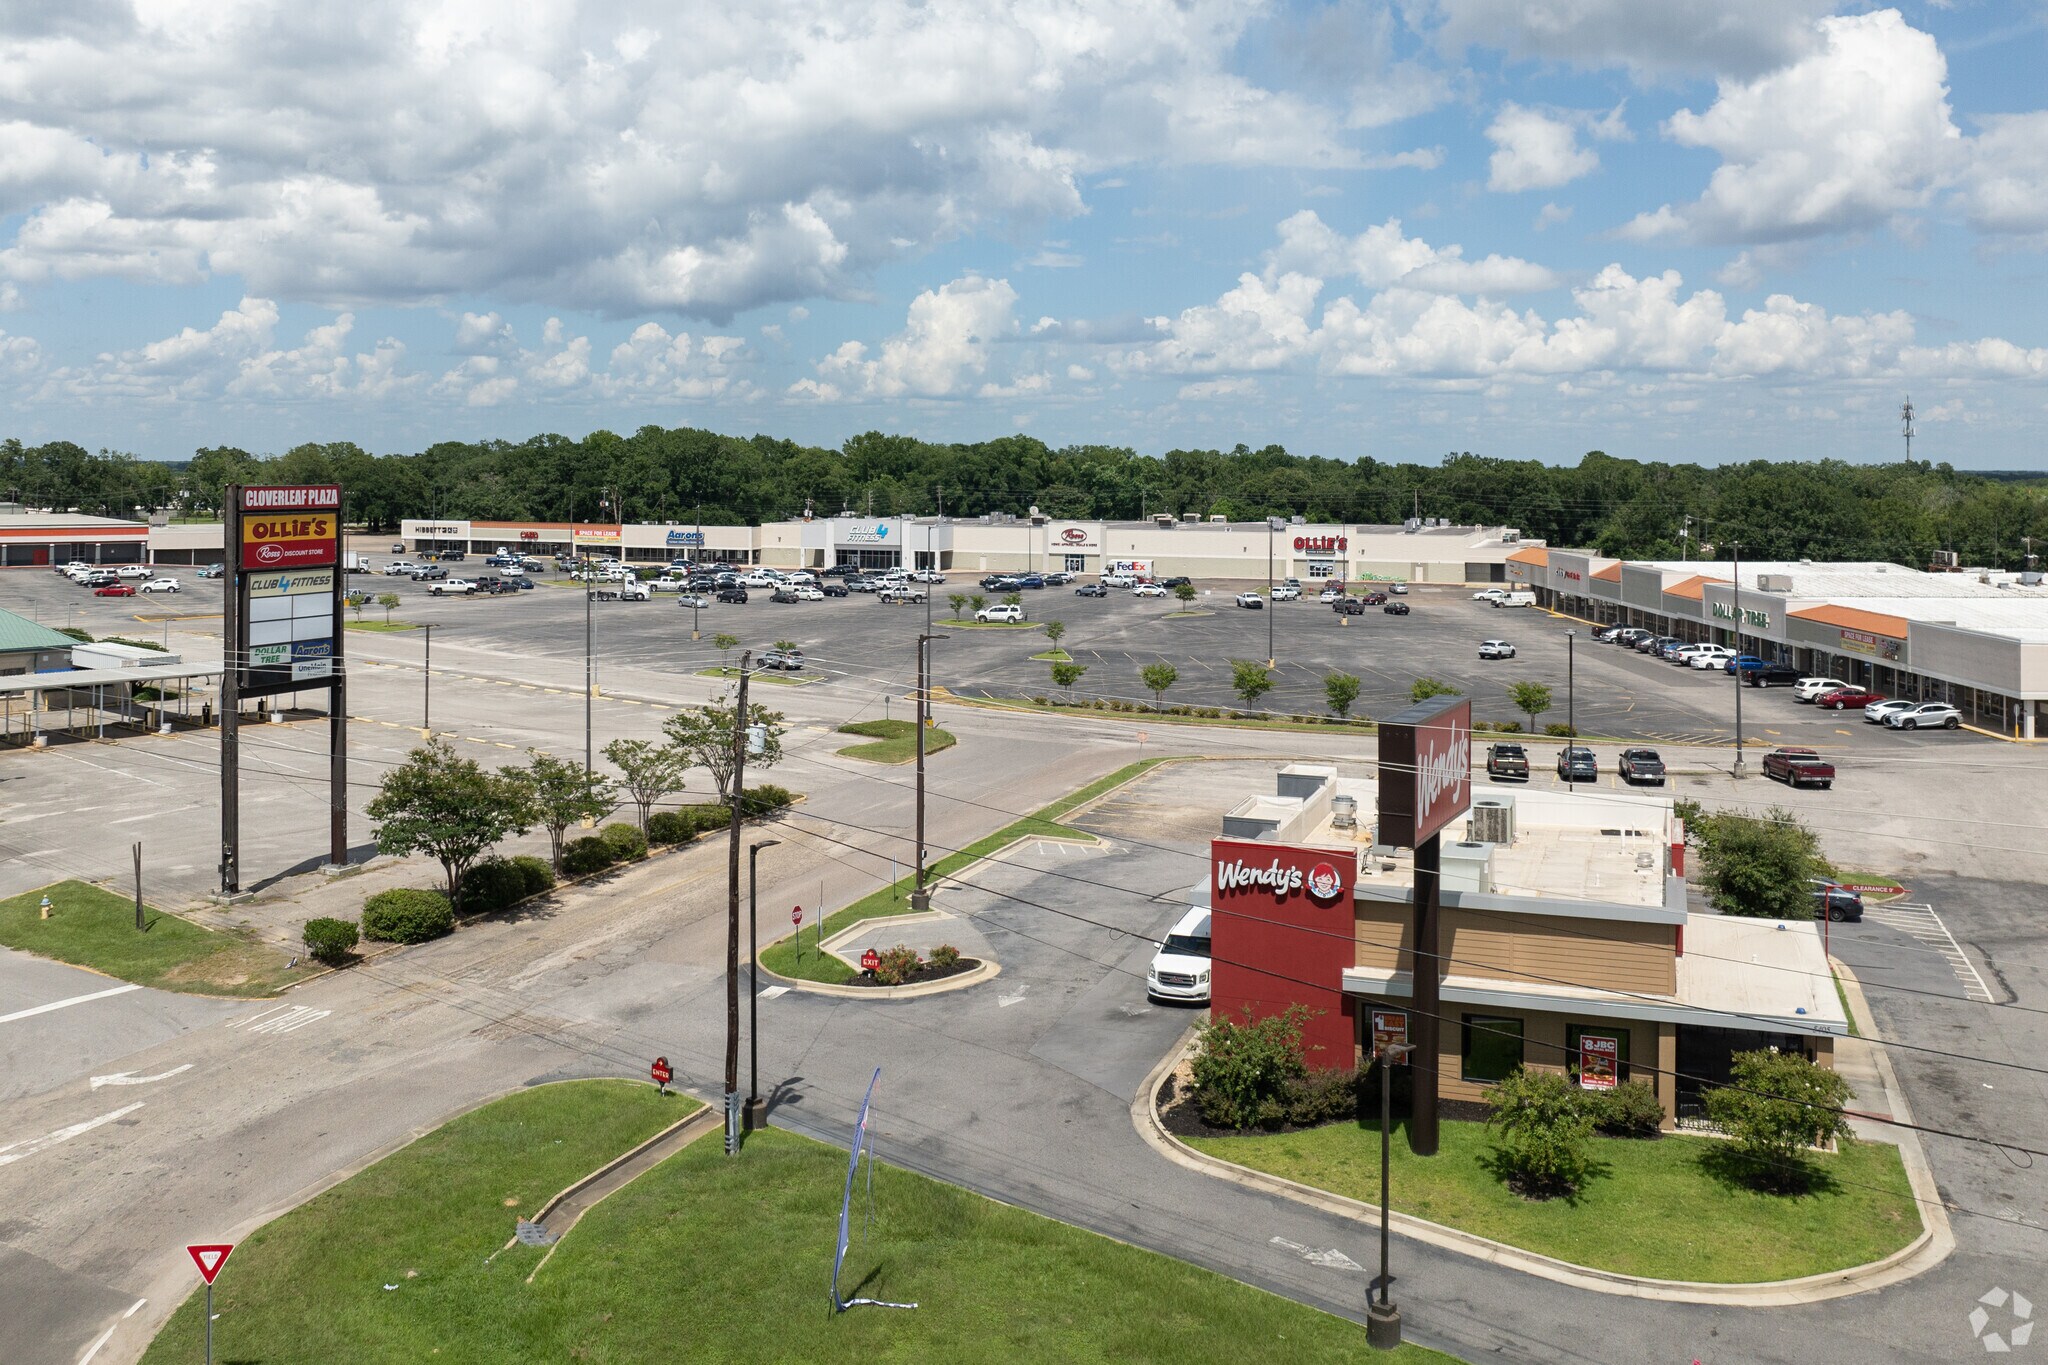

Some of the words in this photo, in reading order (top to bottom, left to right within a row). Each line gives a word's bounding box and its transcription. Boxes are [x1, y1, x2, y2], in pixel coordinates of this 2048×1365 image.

[245, 489, 307, 507] CLOVERLEAF
[308, 489, 338, 505] PLAZA
[849, 525, 877, 535] CLUB
[284, 549, 308, 557] DISCOUNT
[1117, 561, 1146, 571] FedEx
[251, 579, 280, 591] CLUB
[291, 575, 331, 588] FITNESS
[1713, 602, 1744, 623] DOLLAR
[1745, 608, 1769, 629] TREE
[254, 645, 287, 656] DOLLAR
[260, 655, 281, 664] TREE
[1417, 719, 1468, 829] Wendy's
[1218, 858, 1304, 895] Wendy's
[1594, 1040, 1615, 1050] JBC
[653, 1069, 669, 1078] ENTER
